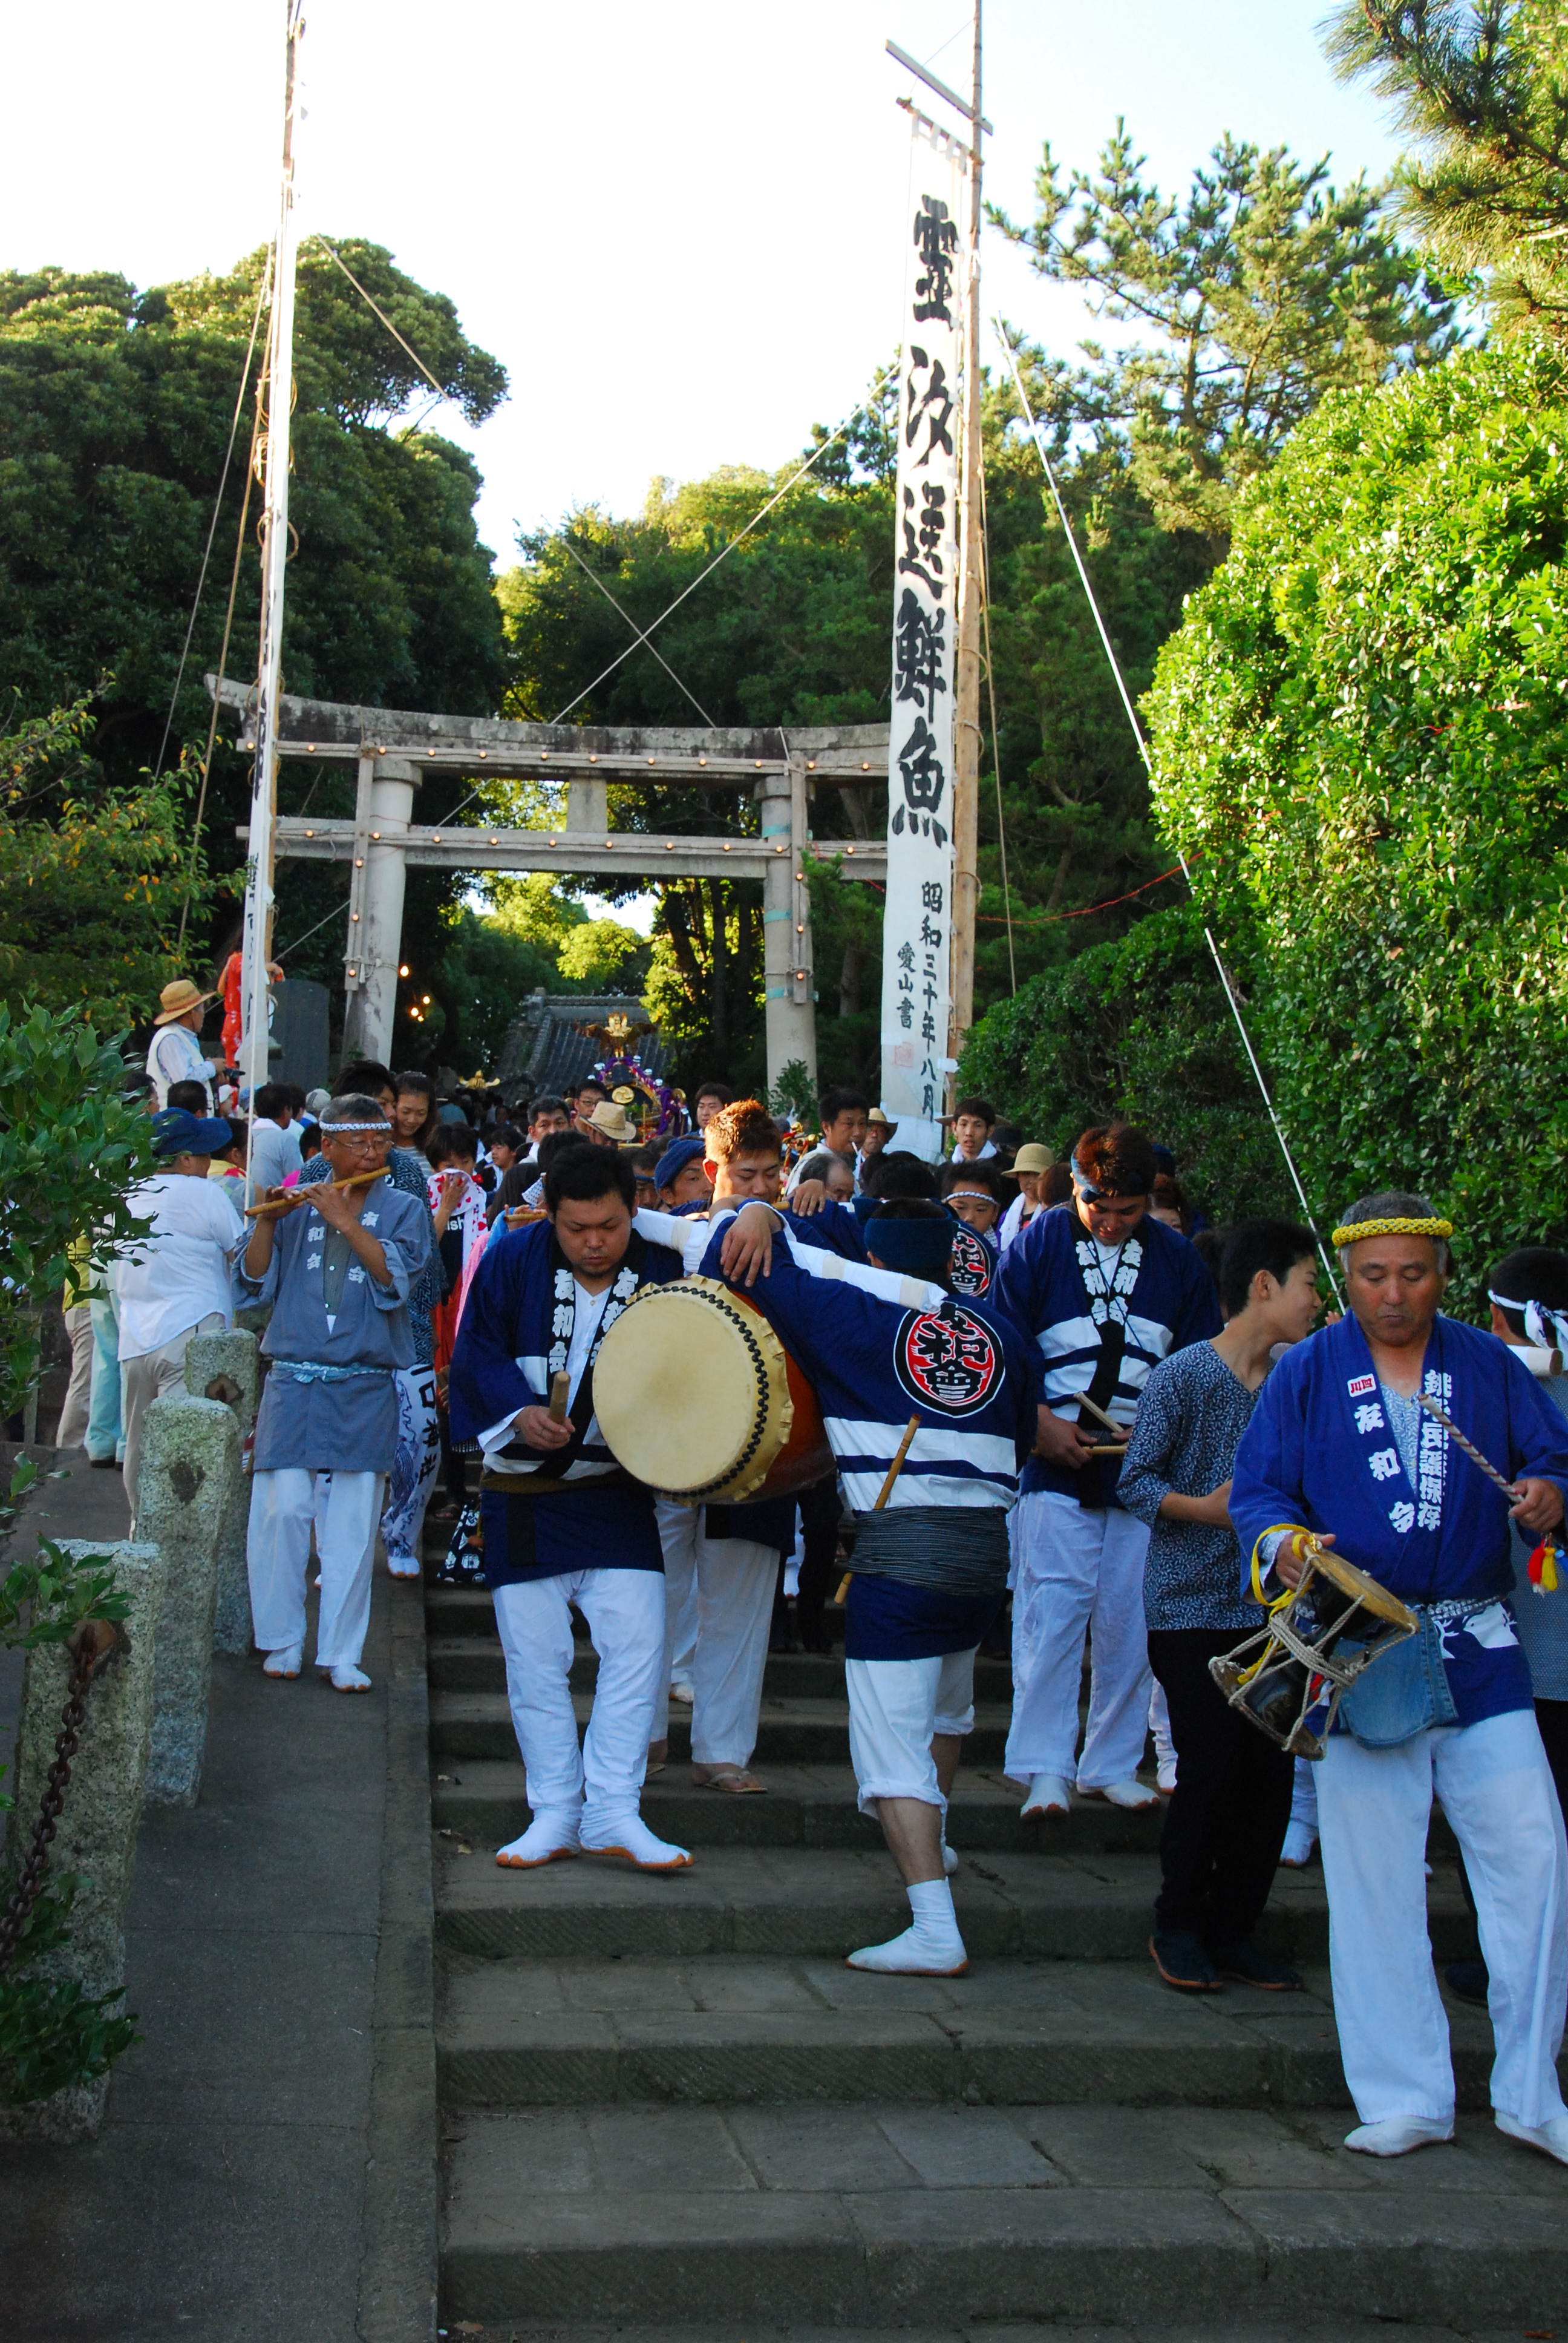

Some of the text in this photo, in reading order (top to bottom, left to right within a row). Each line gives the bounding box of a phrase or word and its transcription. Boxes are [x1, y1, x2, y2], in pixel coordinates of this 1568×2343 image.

[920, 881, 944, 1122] 昭和三十年八月
